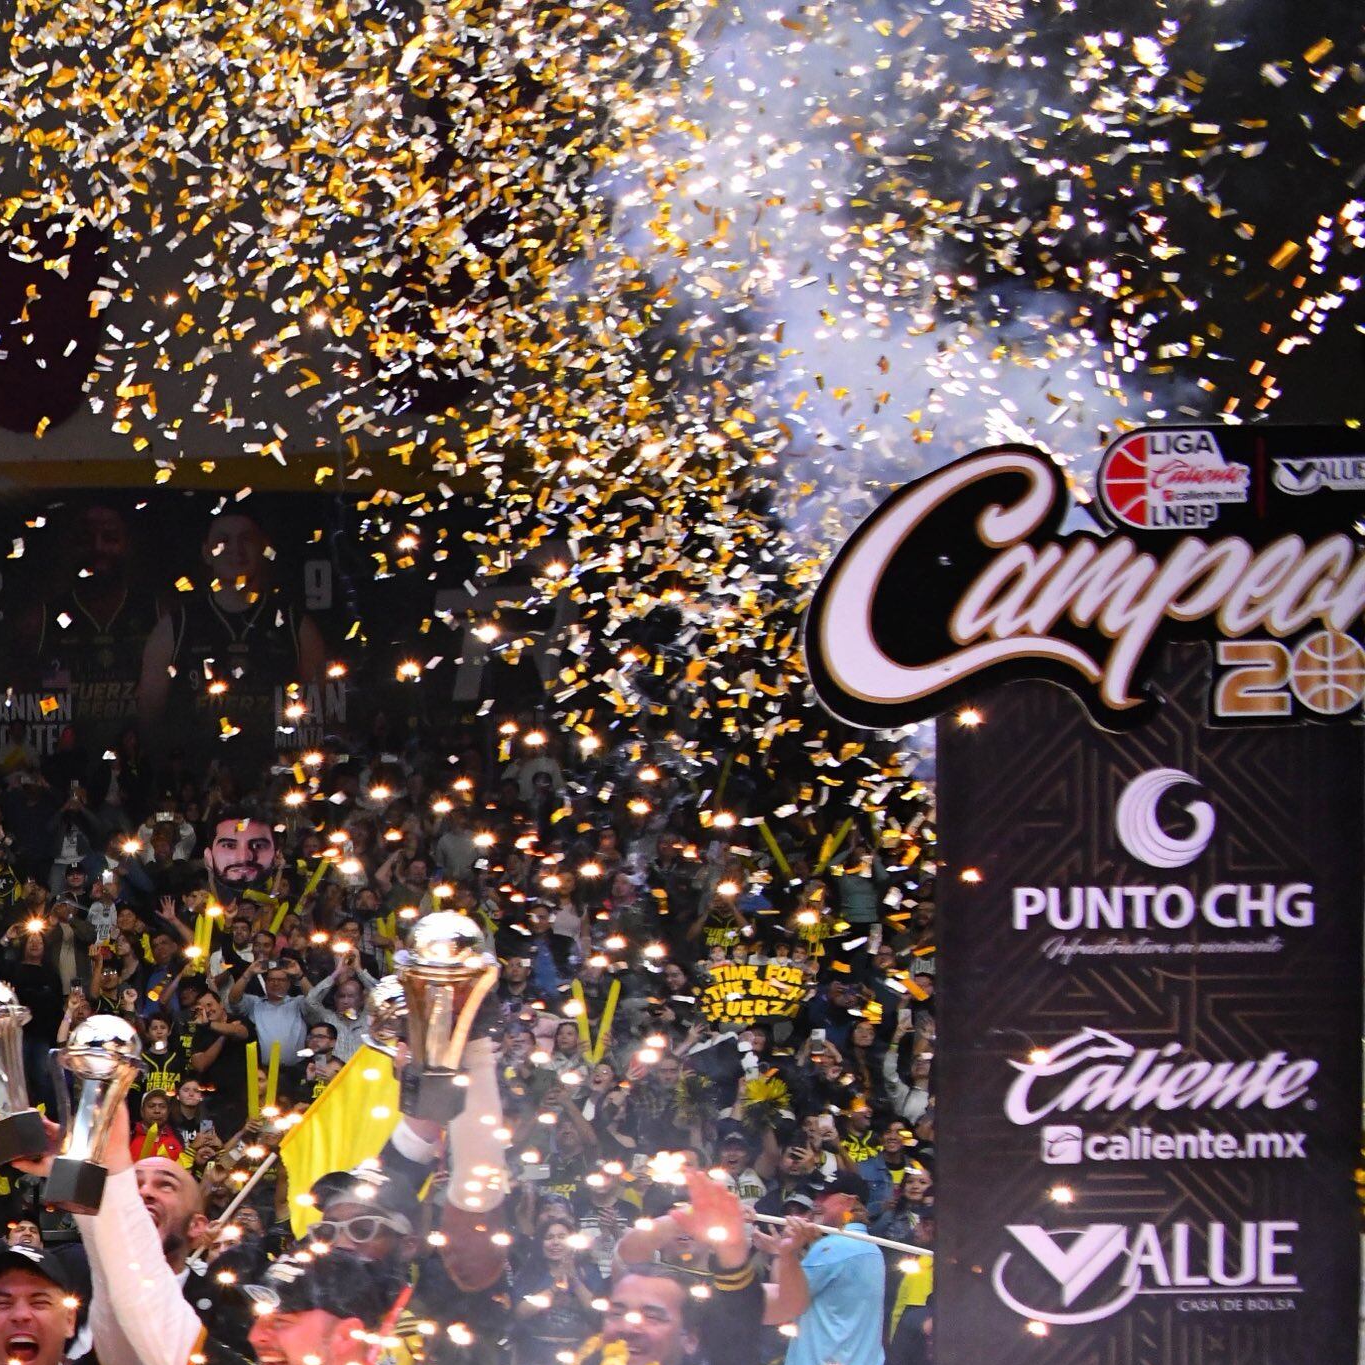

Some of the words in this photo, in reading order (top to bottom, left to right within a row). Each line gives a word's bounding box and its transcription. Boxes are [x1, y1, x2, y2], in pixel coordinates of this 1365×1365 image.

[1150, 433, 1216, 455] LIGA
[1150, 504, 1215, 527] LNBP
[1012, 884, 1196, 931] PUNTO
[1200, 883, 1316, 928] CHG
[710, 965, 758, 984] TIME
[766, 965, 806, 986] FOR
[704, 981, 742, 1003] THE
[710, 999, 801, 1019] FUERZA
[1004, 1025, 1319, 1126] Caliente
[1083, 1127, 1307, 1161] caliente.mx
[993, 1220, 1300, 1310] VALUE
[1178, 1299, 1219, 1312] CASA
[1222, 1299, 1244, 1312] DE
[1247, 1298, 1297, 1311] BOLSA
